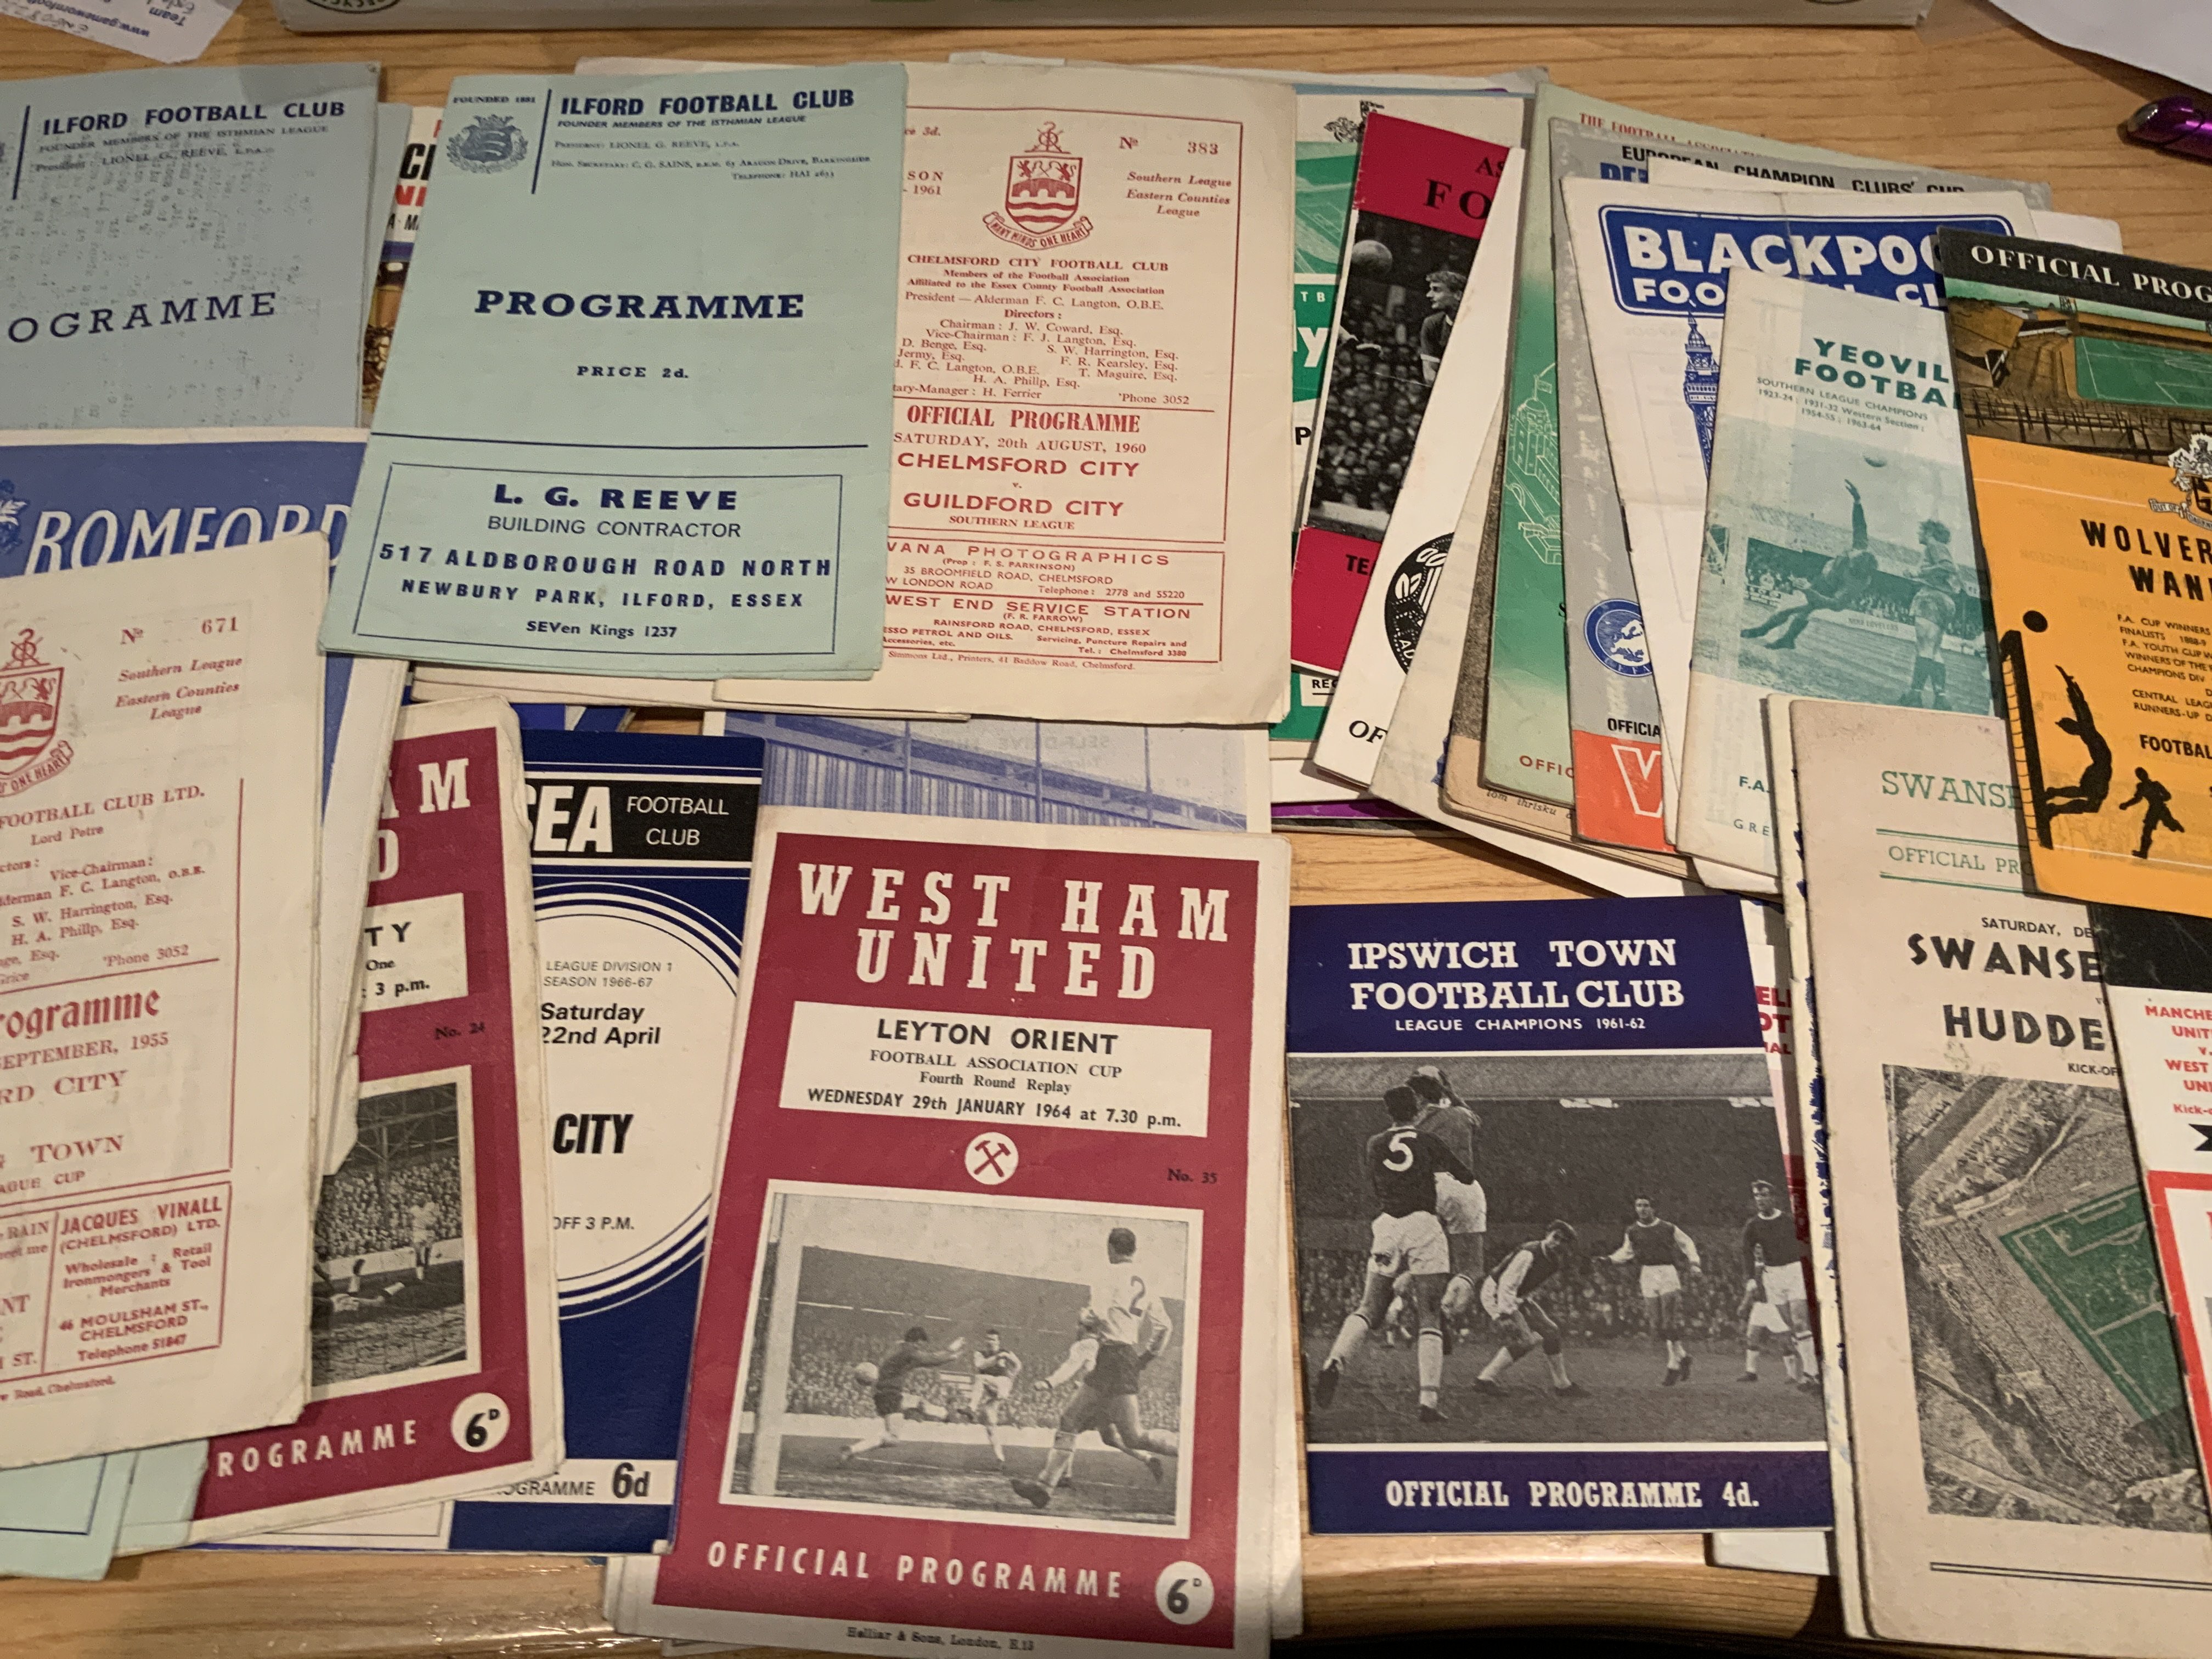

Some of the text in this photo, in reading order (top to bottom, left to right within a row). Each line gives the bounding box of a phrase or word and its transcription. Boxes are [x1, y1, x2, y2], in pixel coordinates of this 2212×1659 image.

[561, 89, 855, 116] ILFORD FOOTBALL CLUB
[43, 101, 345, 136] ILFORD FOOTBALL CLUB
[558, 120, 608, 128] FOUNDER
[711, 117, 763, 126] ISTHMIAN
[1187, 142, 1218, 154] 383
[1127, 172, 1231, 188] Southern League
[1126, 189, 1231, 205] Eastern Counties
[908, 255, 1169, 272] CHELMSFORD CITY FOOTBALL CLUB
[1971, 246, 2212, 303] OFFICIAL PROG
[1075, 273, 1129, 284] Association
[474, 290, 804, 319] PROGRAMME
[905, 291, 1164, 311] President Alderman O.B.E.
[577, 366, 689, 379] PRICE 2d.
[1813, 338, 1948, 383] YEOVIL
[1757, 377, 1928, 421] SOUTHERN LEAGUE CHAMPIONS
[907, 405, 1140, 433] OFFICIAL PROGRAMME
[894, 432, 1146, 454] SATURDAY, 20th AUGUST, 1960
[897, 453, 1140, 477] CHELMSFORD CITY
[494, 484, 737, 510] L. G. REEVE
[903, 492, 1124, 517] GUILDFORD CITY
[488, 515, 742, 538] BUILDING CONTRACTOR
[949, 515, 1075, 530] SOUTHERN LEAGUE
[379, 544, 832, 577] 517 ALDBOROUGH ROAD NORTH
[968, 546, 1169, 566] PHOTOGRAPHICS
[921, 566, 1113, 585] BROOMFIELD ROAD, CHELMSFORD
[2129, 565, 2212, 602] WAN
[401, 579, 803, 610] NEWBURY PARK, ILFORD, ESSEX
[1133, 589, 1184, 599] and 55220
[886, 595, 1190, 619] WEST END SERVICE STATION
[201, 616, 239, 635] 671
[526, 620, 677, 639] SEVen Kings 1237
[2120, 627, 2165, 640] FINALISTS
[2165, 622, 2210, 635] WINNERS
[117, 657, 242, 682] Southern League
[115, 682, 240, 709] Eastern Counties
[2132, 689, 2177, 703] CENTRAL
[150, 703, 201, 720] League
[1349, 720, 1387, 744] OF
[2140, 734, 2212, 759] FOOTBAL
[1520, 755, 1575, 778] OFFIC
[104, 785, 205, 811] CLUB LTD.
[627, 796, 729, 816] FOOTBALL
[31, 825, 104, 847] Lord Petre
[646, 828, 701, 847] CLUB
[1734, 819, 1770, 837] GRE
[1888, 846, 1985, 871] OFFICIAL
[798, 863, 1229, 942] WEST HAM
[1982, 917, 2061, 938] SATURDAY,
[366, 958, 395, 972] One
[546, 961, 661, 972] LEAGUE DIVISION
[855, 928, 1156, 1000] UNITED
[1348, 939, 1676, 970] IPSWICH TOWN
[1908, 933, 2103, 983] SWANSE
[396, 979, 431, 997] p.m.
[543, 977, 653, 988] SEASON 1966-67
[1350, 980, 1684, 1011] FOOTBALL CLUB
[541, 1004, 645, 1024] Saturday
[1396, 1018, 1646, 1031] LEAGUE CHAMPIONS 1961-62
[2145, 1006, 2212, 1020] MANCHE
[604, 1027, 661, 1047] April
[877, 1018, 1119, 1056] LEYTON ORIENT
[1943, 1005, 2105, 1050] HUDDE
[131, 1032, 169, 1050] 1955
[870, 1049, 1123, 1080] FOOTBALL ASSOCIATION CUP
[2165, 1059, 2208, 1073] WEST
[54, 1070, 128, 1096] CITY
[919, 1071, 1072, 1095] Fourth Round Replay
[807, 1088, 1181, 1130] WEDNESDAY 29th JANUARY 1964 at 7.30 p.m.
[553, 1113, 634, 1154] CITY
[30, 1135, 124, 1164] TOWN
[1383, 1131, 1418, 1172] 5
[1167, 1168, 1217, 1185] No. 35
[60, 1196, 223, 1235] JACQUES VINALL
[601, 1217, 635, 1230] P.M.
[59, 1224, 178, 1254] (CHELMSFORD)
[65, 1243, 212, 1276] Wholesale Retail
[1129, 1276, 1144, 1317] 2
[81, 1316, 188, 1341] CHELMSFORD
[218, 1419, 417, 1477] ROGRAMME
[612, 1462, 651, 1499] 6d
[1385, 1481, 1759, 1508] OFFICIAL PROGRAMME 4d.
[707, 1541, 1122, 1599] OFFICIAL PROGRAMME
